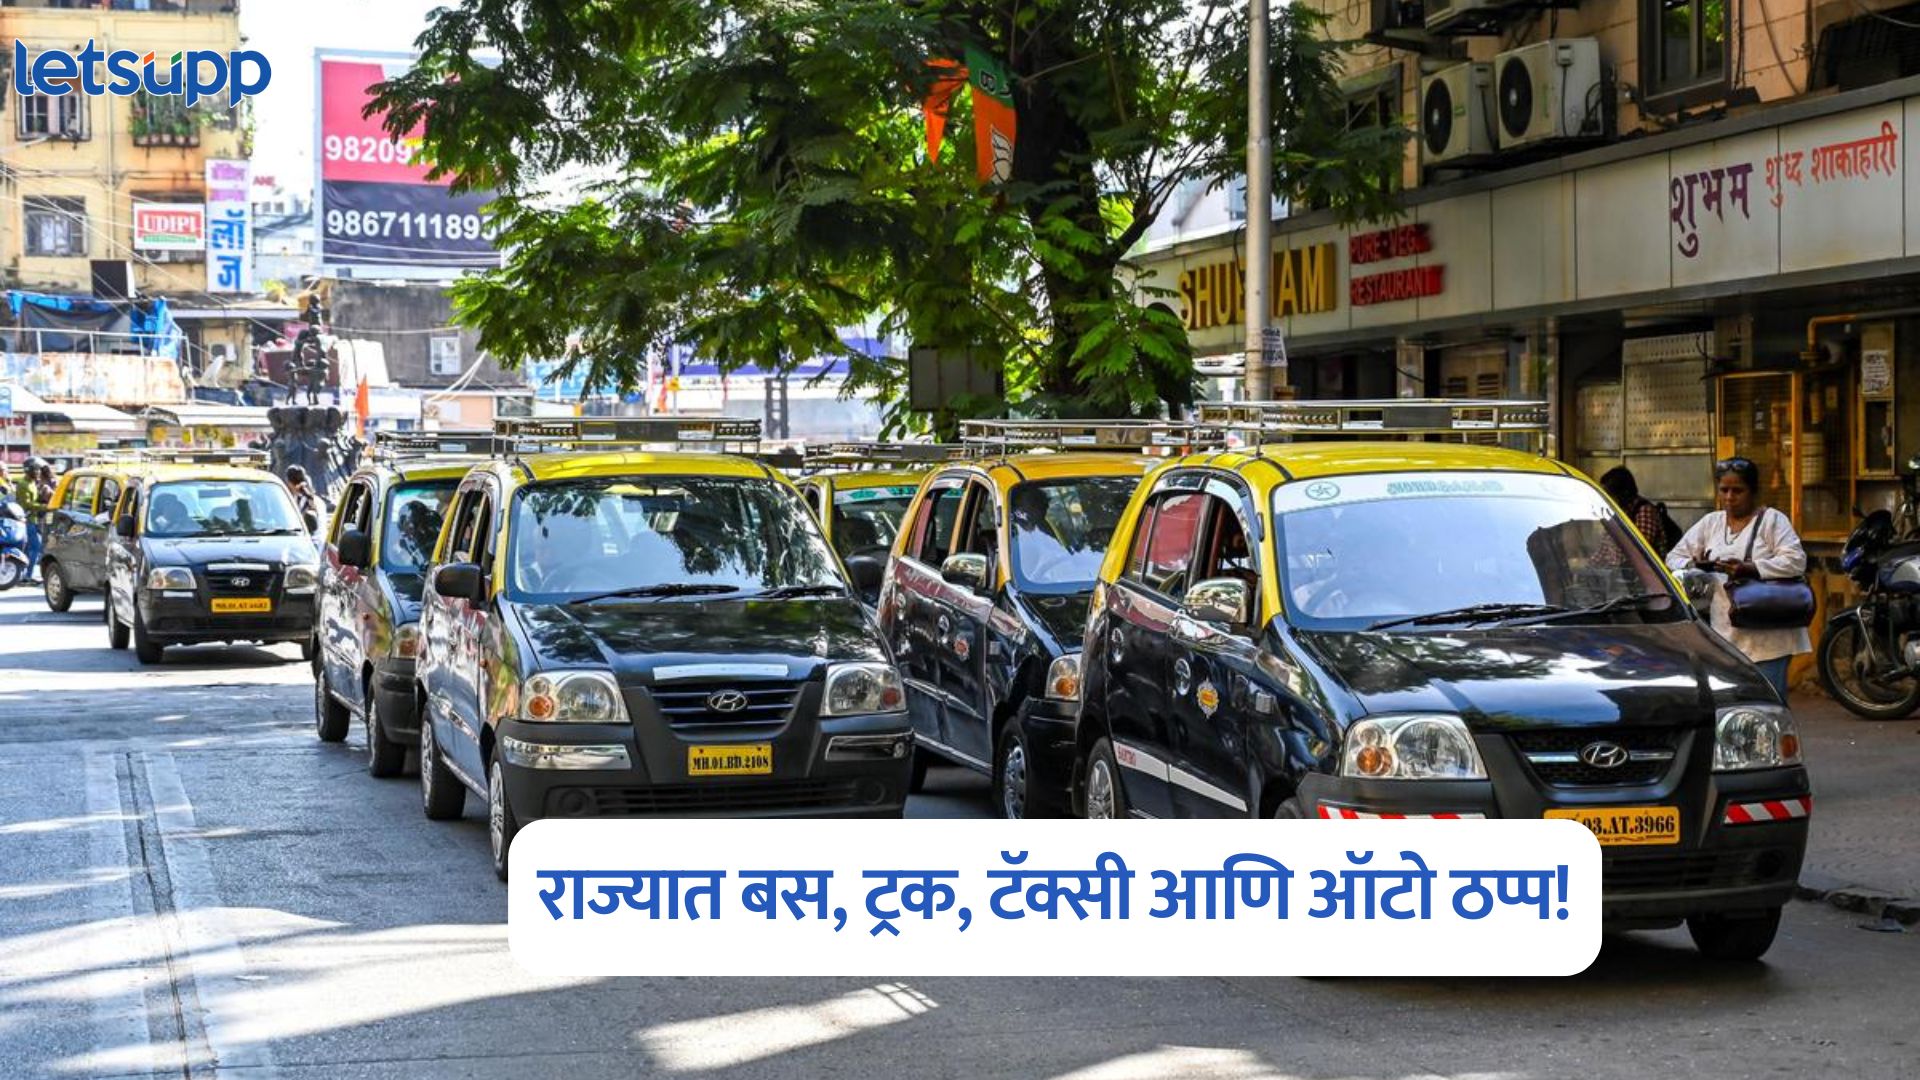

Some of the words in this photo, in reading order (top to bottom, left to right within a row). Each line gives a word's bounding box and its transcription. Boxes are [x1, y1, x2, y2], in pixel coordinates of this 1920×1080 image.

[1670, 162, 1753, 258] शुभम
[1811, 120, 1897, 182] शाकाहारी
[143, 215, 196, 233] UDIPI
[1177, 243, 1331, 330] SHUBAM
[1350, 266, 1442, 306] RESTAURANT
